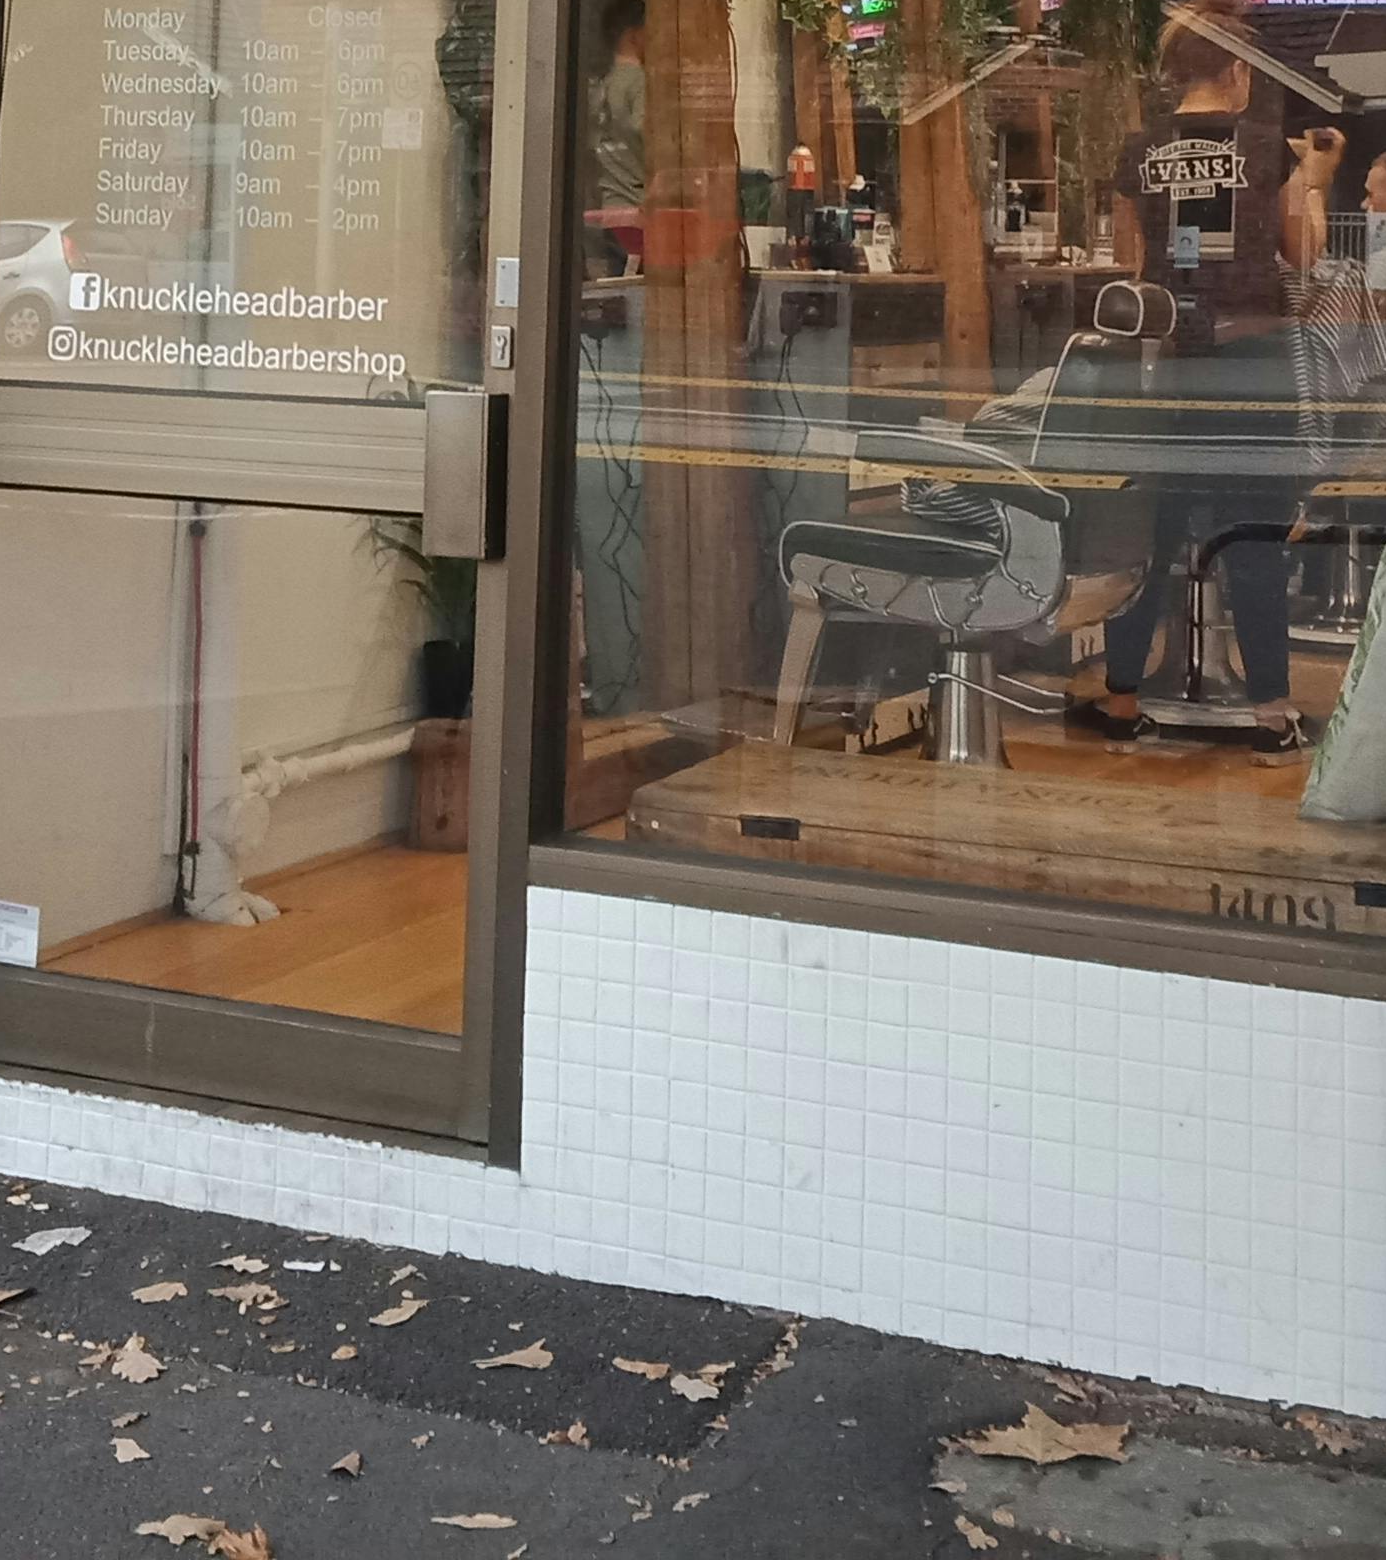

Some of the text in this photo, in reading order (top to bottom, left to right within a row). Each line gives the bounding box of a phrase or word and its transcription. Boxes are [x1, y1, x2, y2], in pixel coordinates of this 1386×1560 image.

[104, 6, 383, 32] Monday Closed
[103, 39, 189, 66] Tuesday
[243, 40, 299, 61] 10am
[338, 41, 385, 66] 6pm
[101, 74, 221, 98] Wednesday
[241, 73, 298, 94] 10am
[337, 75, 384, 98] 6pm
[101, 105, 195, 131] Thursday
[240, 106, 297, 128] 10am
[336, 108, 383, 132] 7pm
[99, 138, 162, 163] Friday
[239, 139, 295, 161] 10am
[335, 141, 381, 165] 7pm
[1156, 157, 1225, 181] VANS
[97, 171, 188, 197] Saturday
[236, 172, 281, 194] 9am
[333, 175, 381, 199] 4pm
[95, 203, 172, 230] Sunday
[236, 206, 292, 228] 10am
[332, 209, 379, 233] 2pm
[102, 278, 388, 321] knuckleheadbarber
[79, 331, 405, 382] knuckleheadbarbershop
